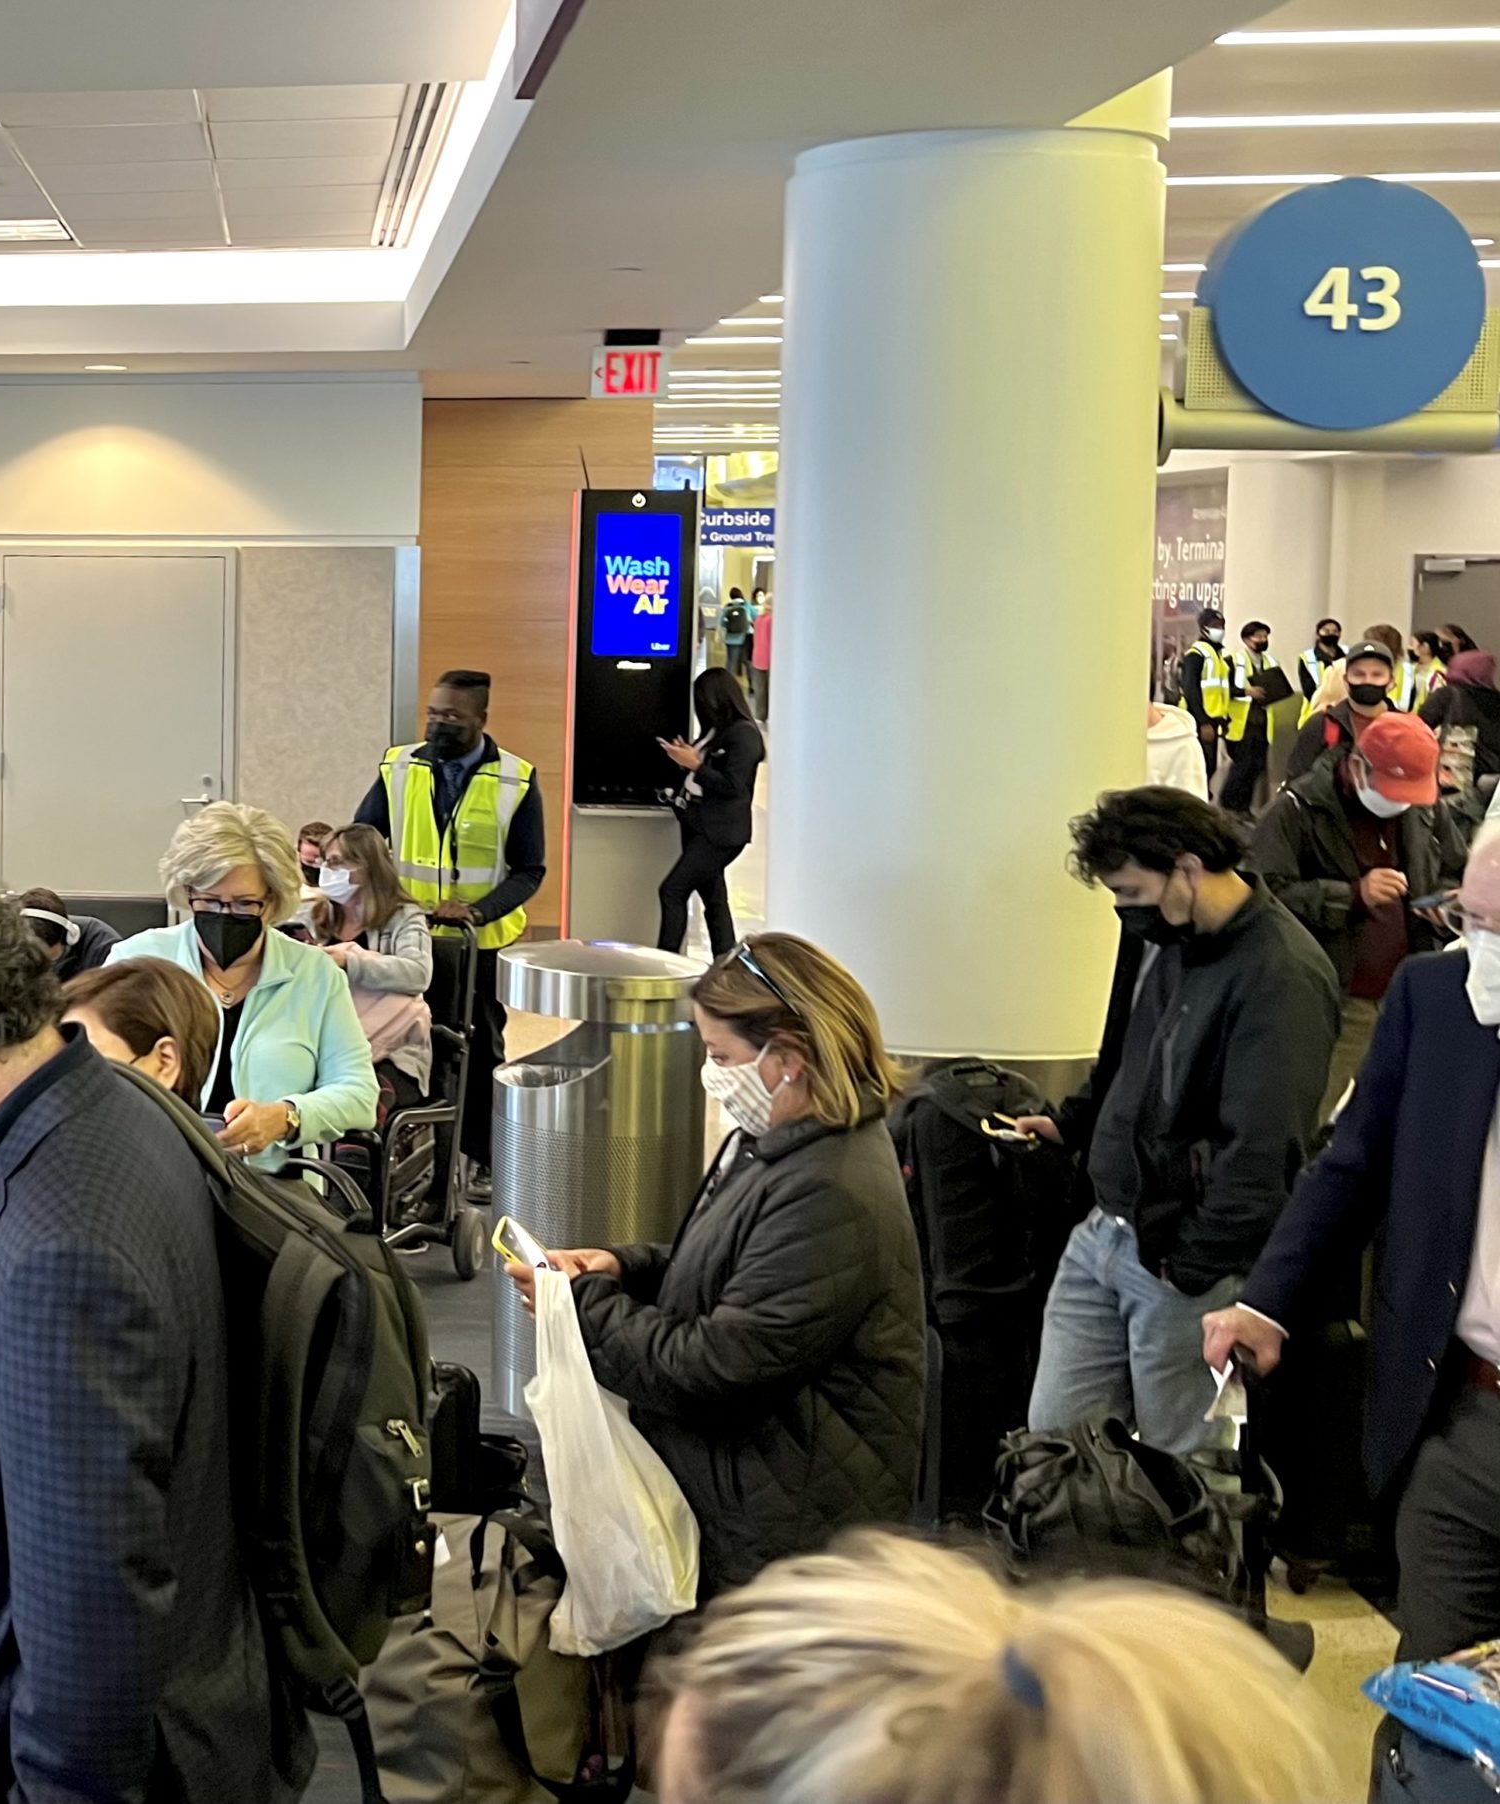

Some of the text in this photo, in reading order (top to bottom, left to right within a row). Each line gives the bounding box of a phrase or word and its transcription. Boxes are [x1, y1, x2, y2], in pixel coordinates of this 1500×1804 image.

[1303, 266, 1401, 331] 43
[604, 352, 662, 395] EXIT
[709, 531, 752, 542] Ground
[1157, 535, 1173, 569] by.
[604, 555, 670, 576] Wash
[606, 575, 669, 595] Wear
[1179, 581, 1193, 601] an
[633, 594, 669, 615] Air
